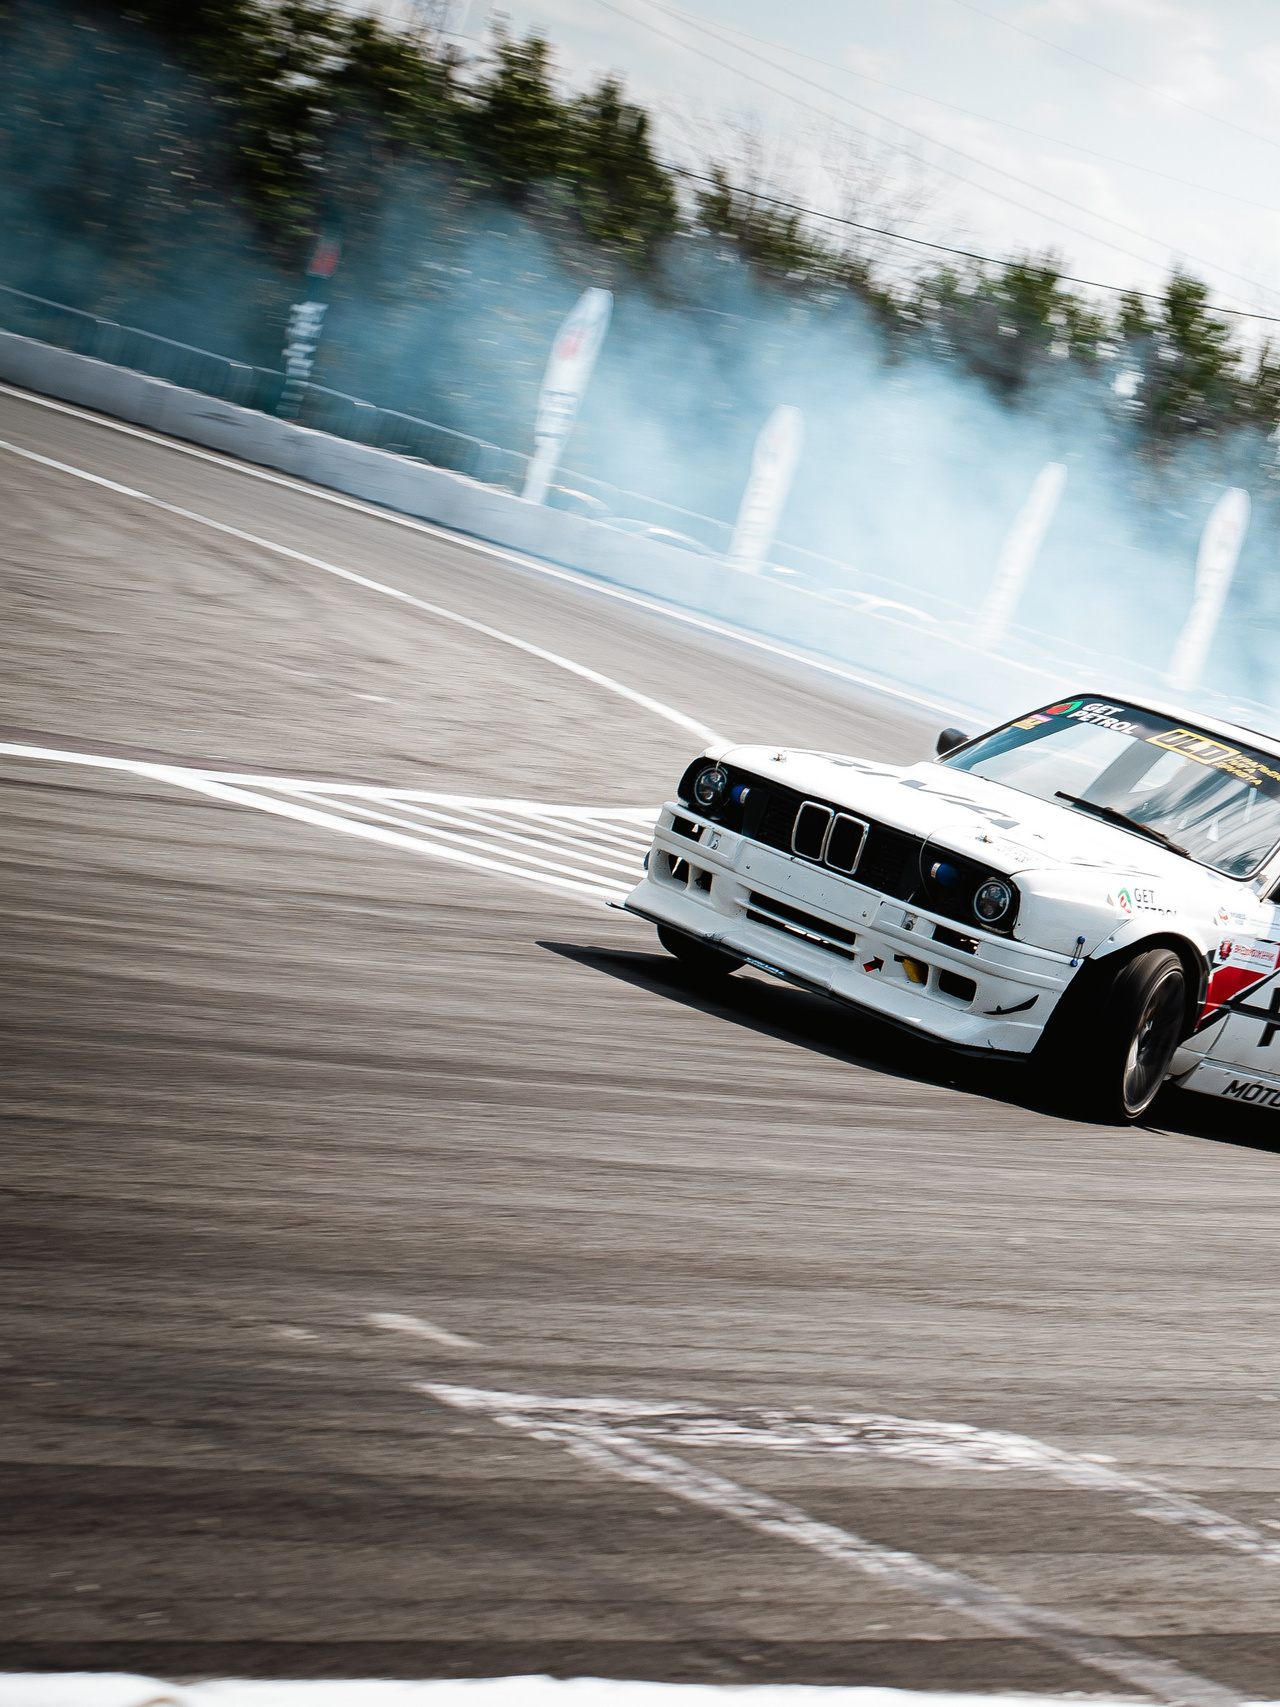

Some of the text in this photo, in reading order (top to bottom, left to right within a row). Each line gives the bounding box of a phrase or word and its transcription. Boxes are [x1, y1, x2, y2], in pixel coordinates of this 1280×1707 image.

[1082, 702, 1125, 716] GET
[1067, 710, 1139, 734] PETROL
[1134, 888, 1154, 904] GET
